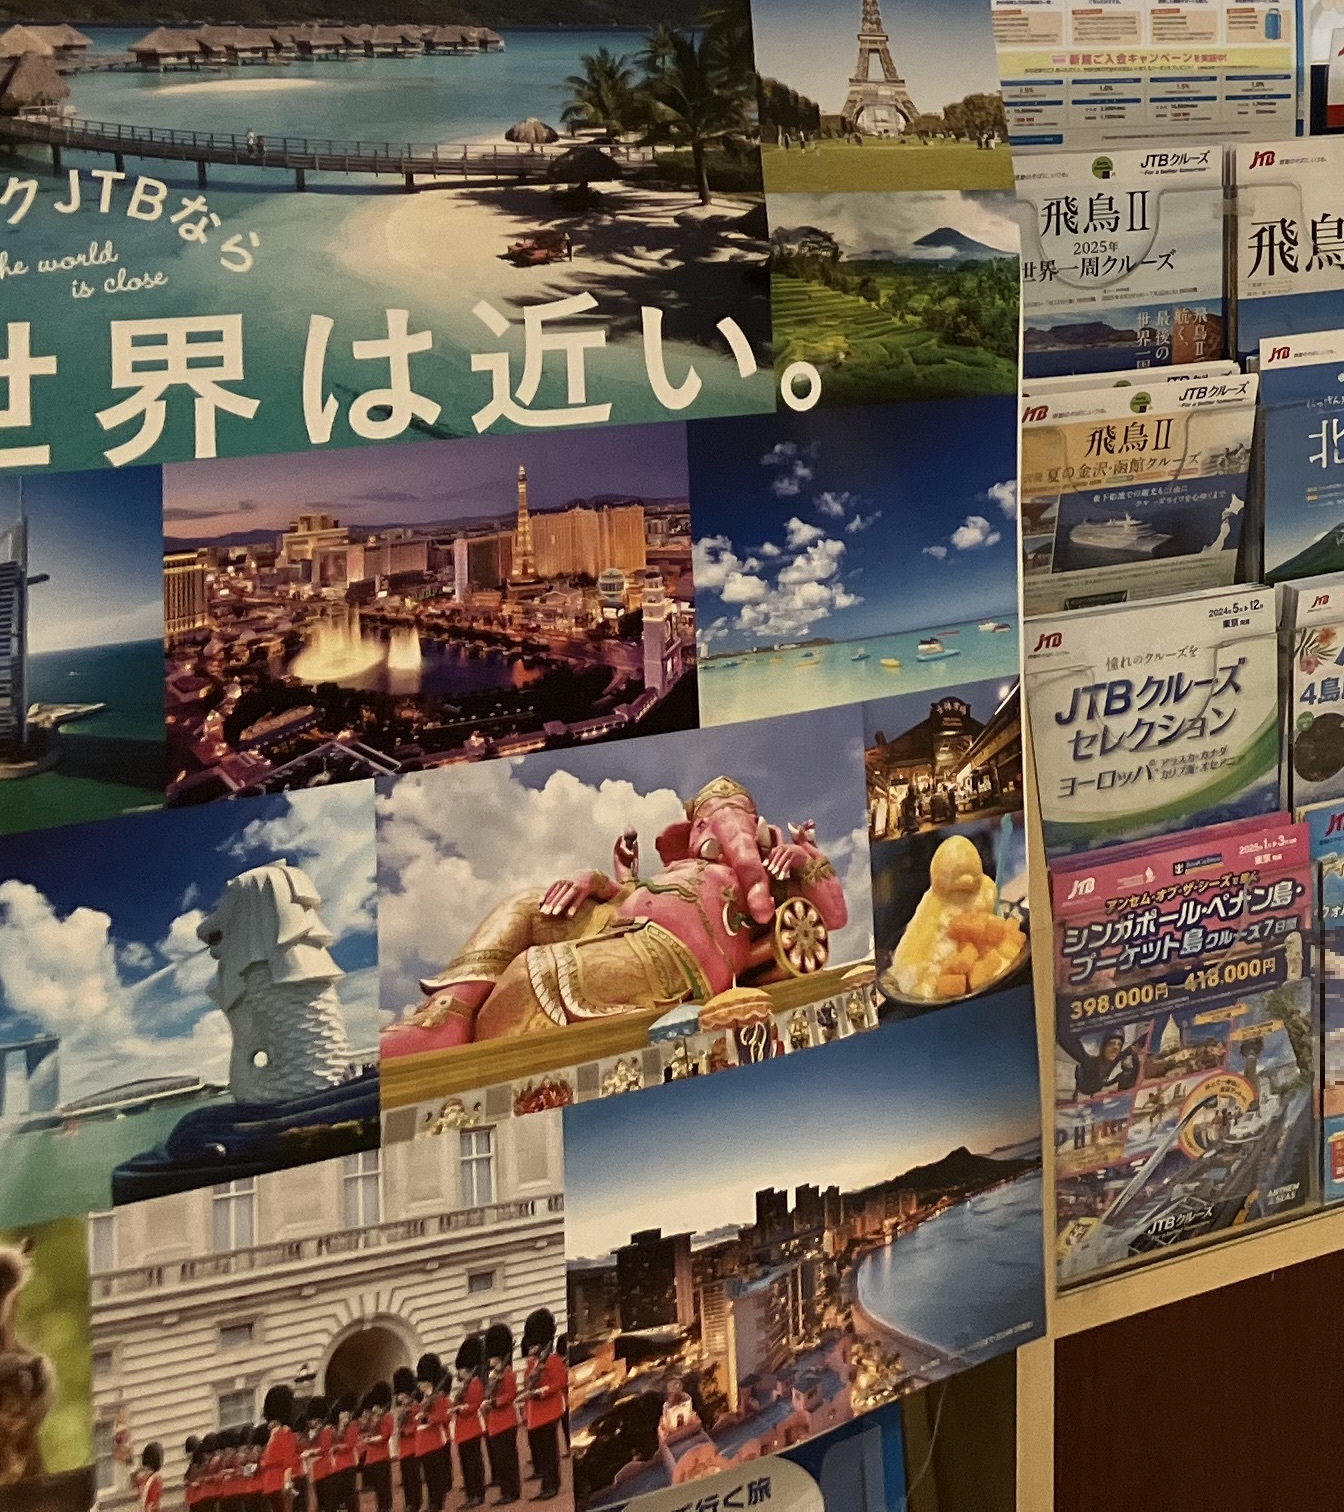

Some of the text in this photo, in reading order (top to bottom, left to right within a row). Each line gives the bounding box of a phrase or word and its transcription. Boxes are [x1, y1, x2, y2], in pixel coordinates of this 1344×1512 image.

[1140, 150, 1211, 169] JTBクルーズ
[1250, 151, 1275, 169] JTB
[38, 240, 119, 272] world
[1073, 240, 1118, 256] 2025年
[1021, 249, 1176, 284] 世界一周クルーズ
[72, 268, 168, 298] is close
[1268, 346, 1290, 363] JTB
[1178, 381, 1249, 402] JTBクルーズ
[1022, 405, 1049, 423] JTB
[1311, 594, 1330, 609] JTB
[1034, 631, 1062, 652] JTB
[1106, 646, 1199, 672] 憧れのクルーズを
[1054, 657, 1248, 728] JTBクルーズ
[1068, 708, 1237, 762] セレクション
[1057, 762, 1151, 799] ヨーロッパ
[1068, 877, 1095, 900] JTB
[1148, 1206, 1213, 1234] JTBクルーズ
